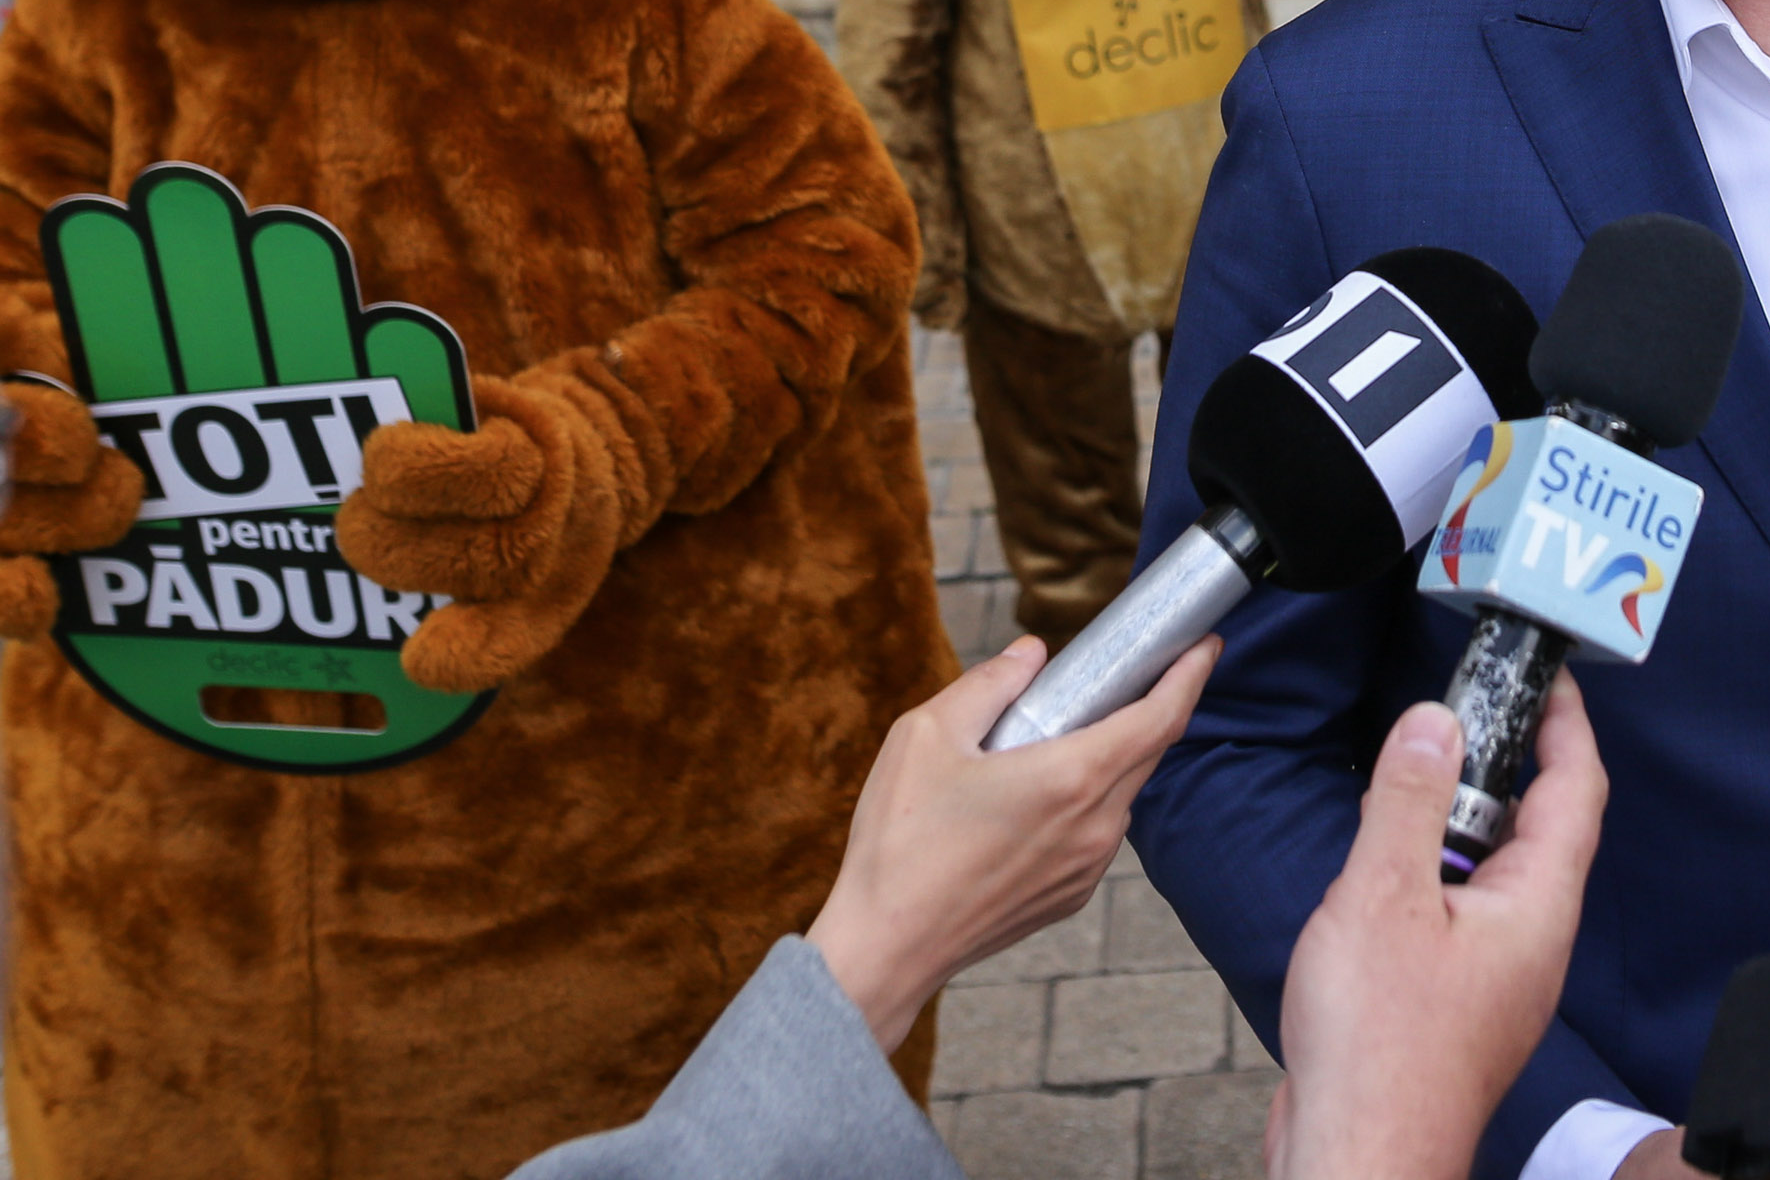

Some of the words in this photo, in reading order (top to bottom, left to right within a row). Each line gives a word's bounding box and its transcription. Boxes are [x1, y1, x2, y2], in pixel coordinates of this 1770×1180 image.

[1064, 11, 1221, 80] declic
[199, 517, 335, 557] pentr
[79, 545, 453, 641] PĂDUR
